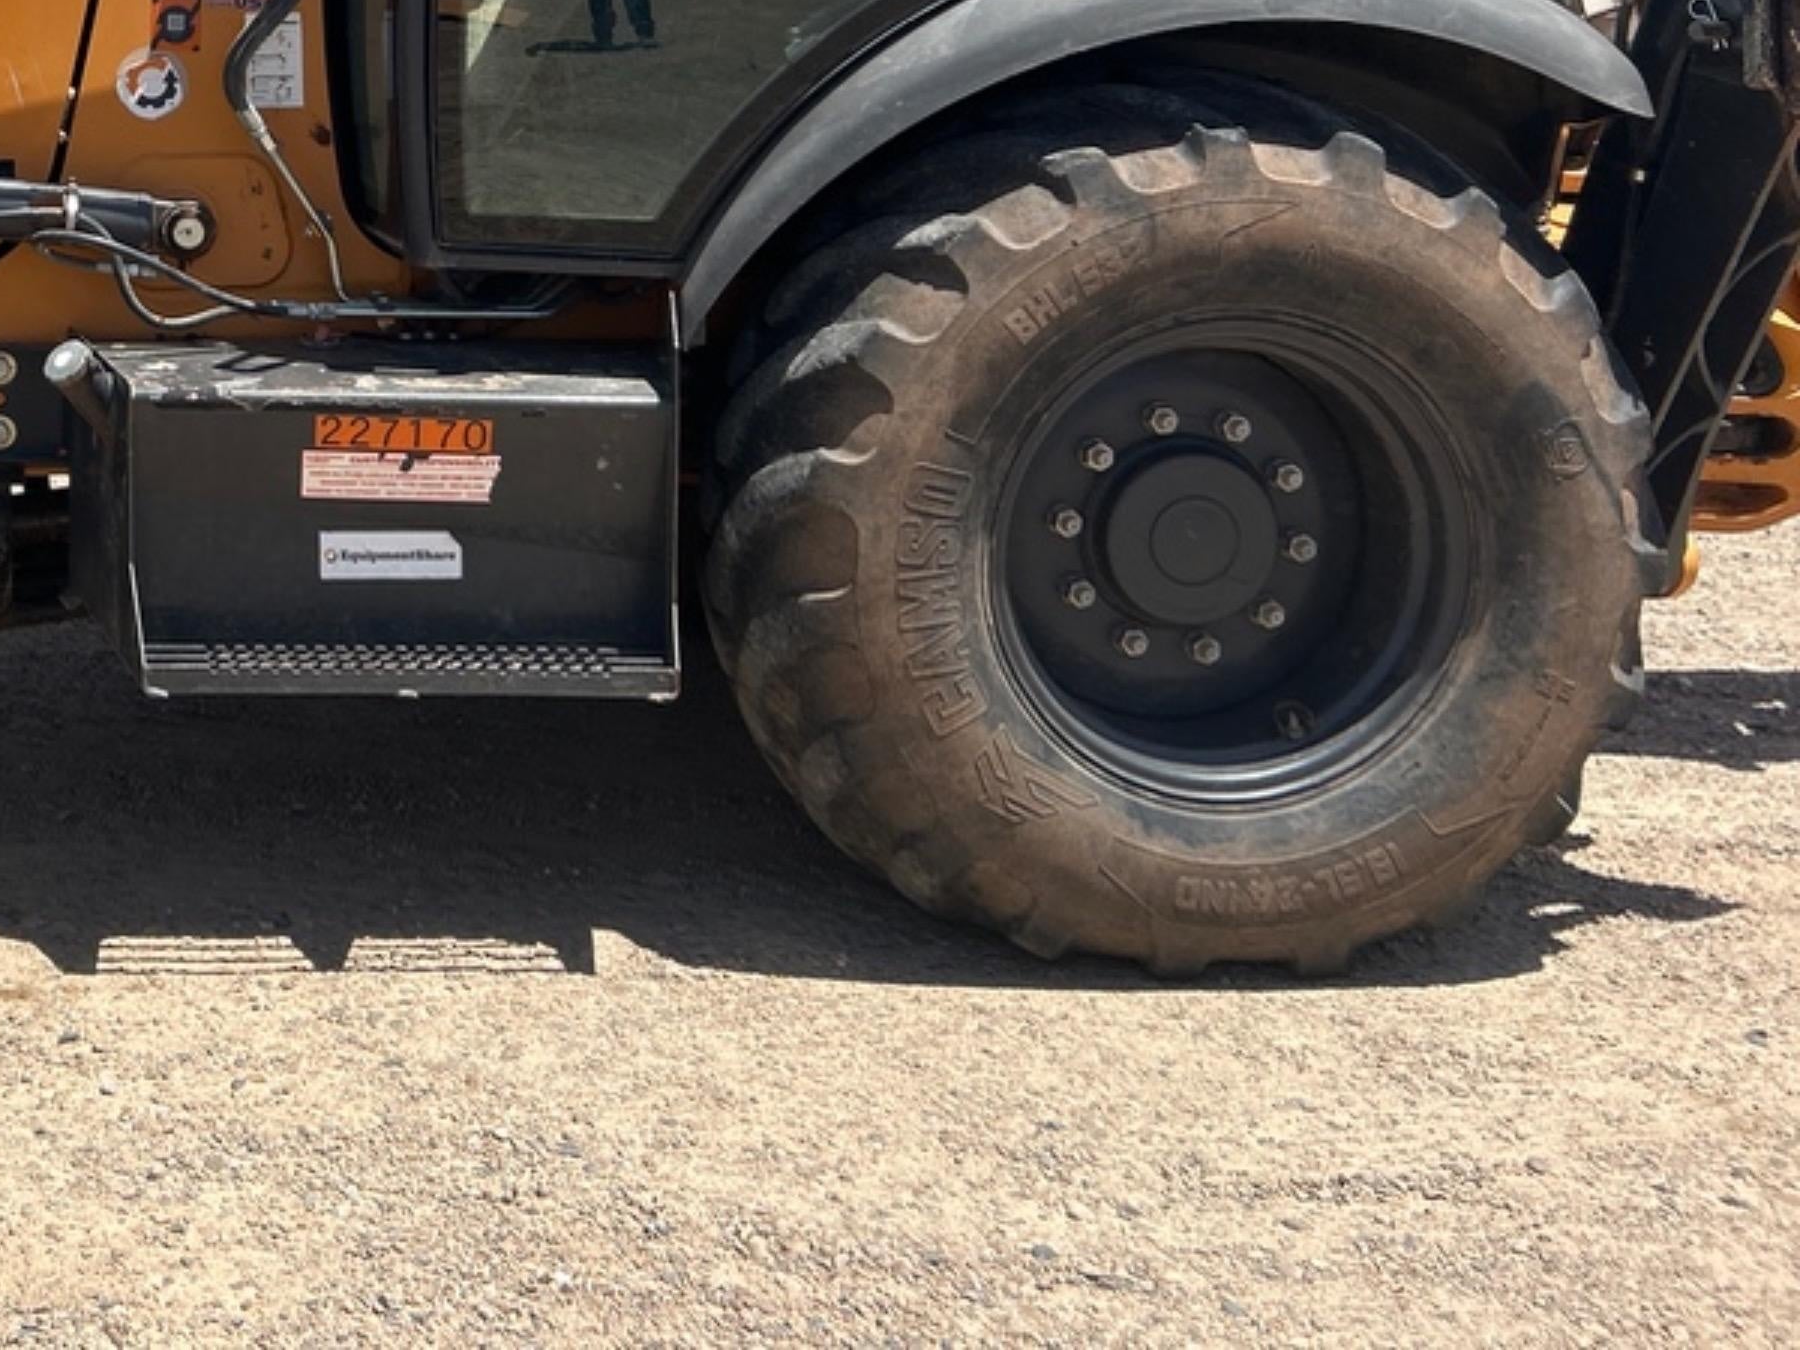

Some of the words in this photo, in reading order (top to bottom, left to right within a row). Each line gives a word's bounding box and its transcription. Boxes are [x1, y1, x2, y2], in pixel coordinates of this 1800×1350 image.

[320, 415, 487, 450] 227170
[340, 549, 456, 564] EquipmentShare
[896, 461, 987, 737] CAMSO
